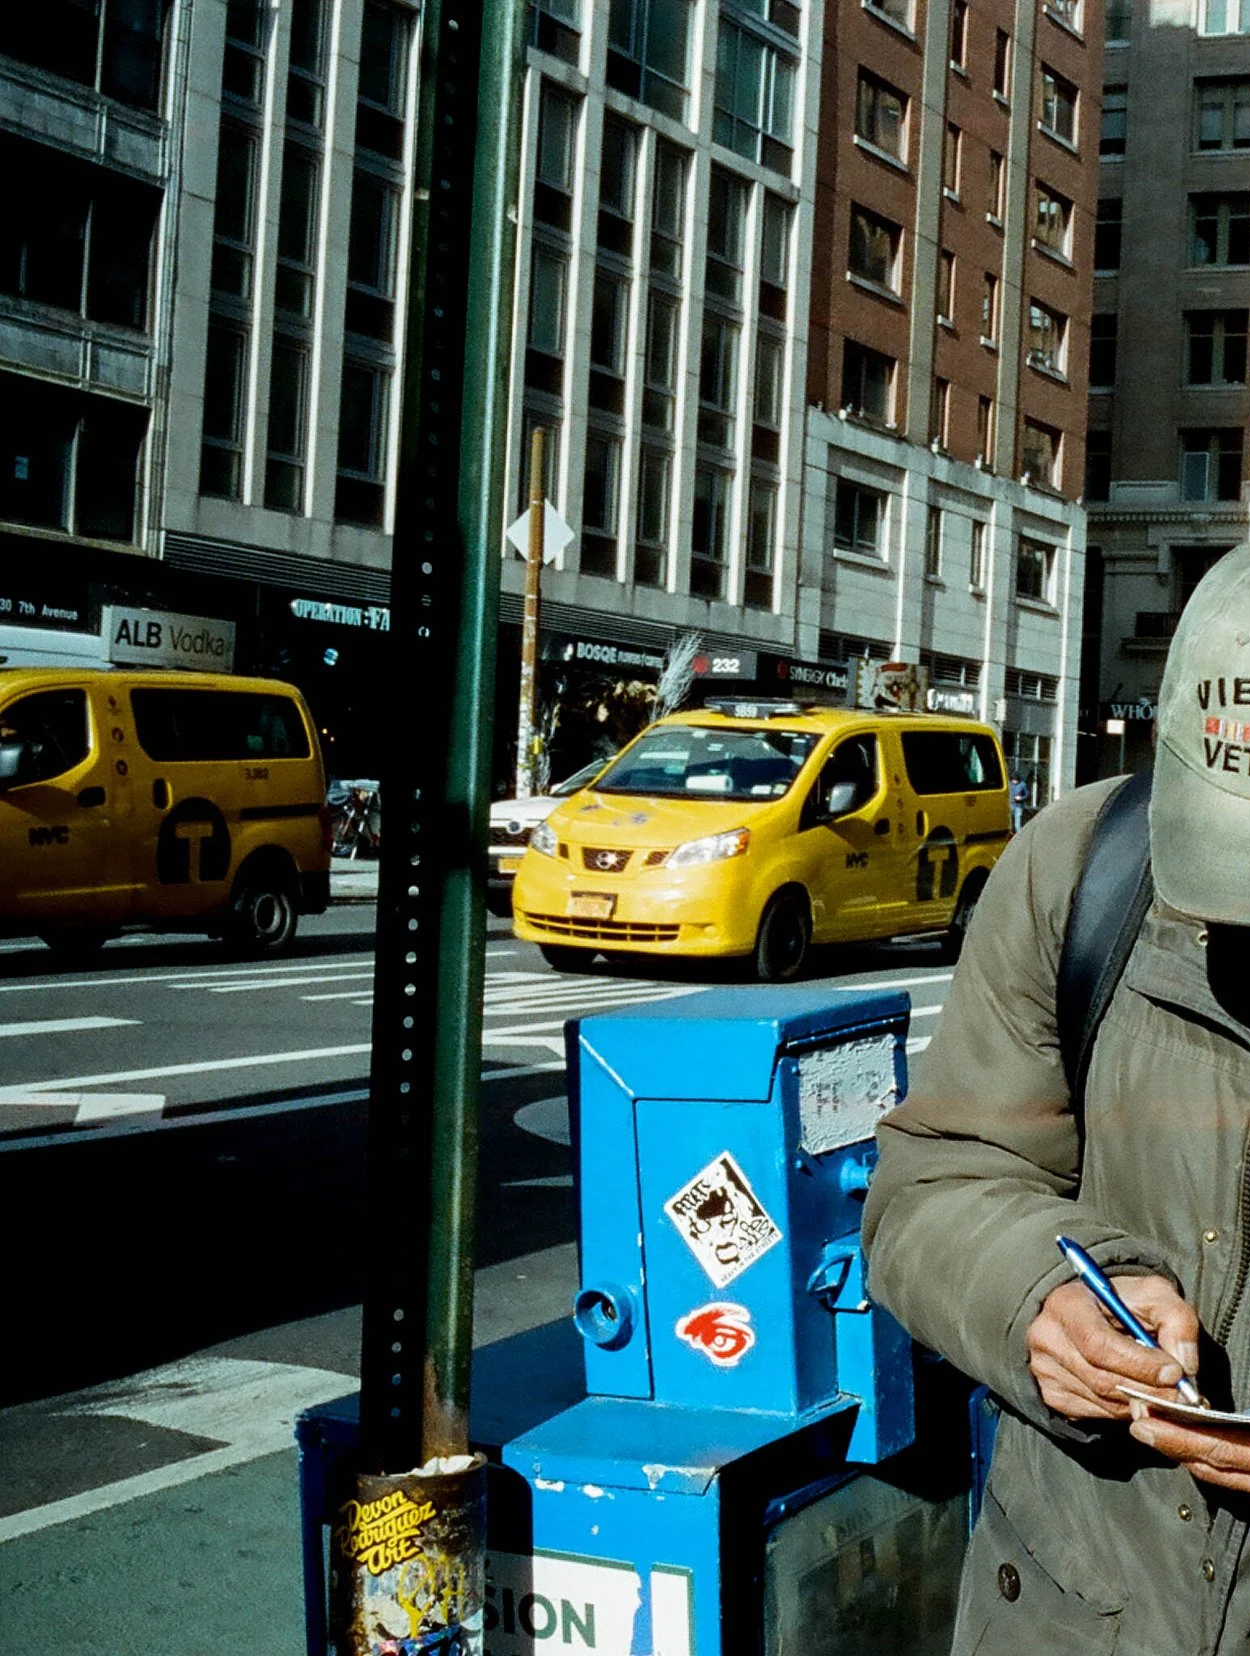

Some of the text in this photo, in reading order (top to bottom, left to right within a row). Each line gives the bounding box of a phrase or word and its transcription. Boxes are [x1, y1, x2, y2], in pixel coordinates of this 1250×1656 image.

[19, 600, 35, 615] 7th
[41, 604, 78, 620] Avenue
[115, 619, 225, 656] ALB Vodka
[577, 641, 617, 664] BOSQE
[712, 658, 740, 673] 232
[28, 825, 70, 846] NYC
[845, 852, 869, 869] NYC
[338, 1490, 408, 1532] Devon
[334, 1501, 437, 1557] Rodriguez
[356, 1540, 421, 1575] Art
